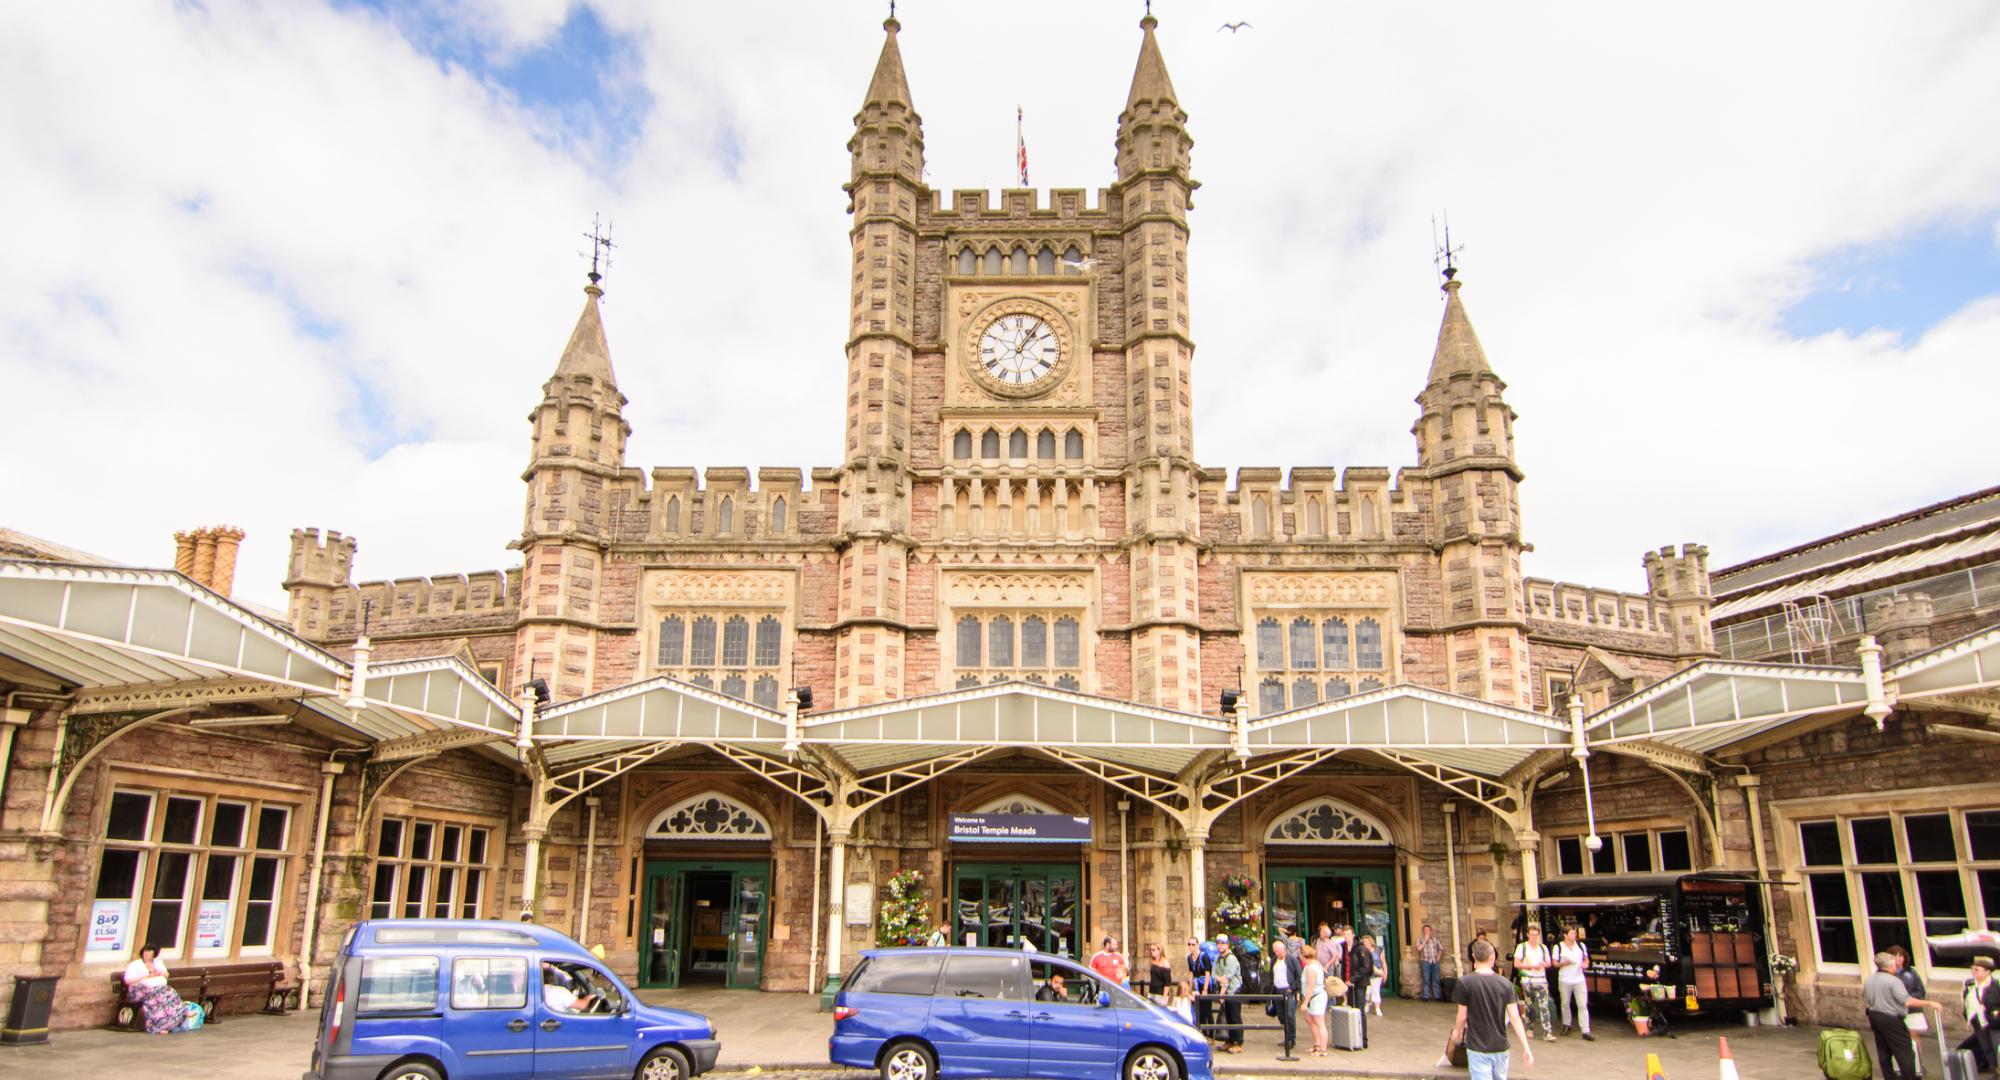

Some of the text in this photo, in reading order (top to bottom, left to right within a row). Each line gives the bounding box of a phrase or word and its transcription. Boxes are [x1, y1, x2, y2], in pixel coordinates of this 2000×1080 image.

[954, 826, 1036, 836] Bristol Temple Meads
